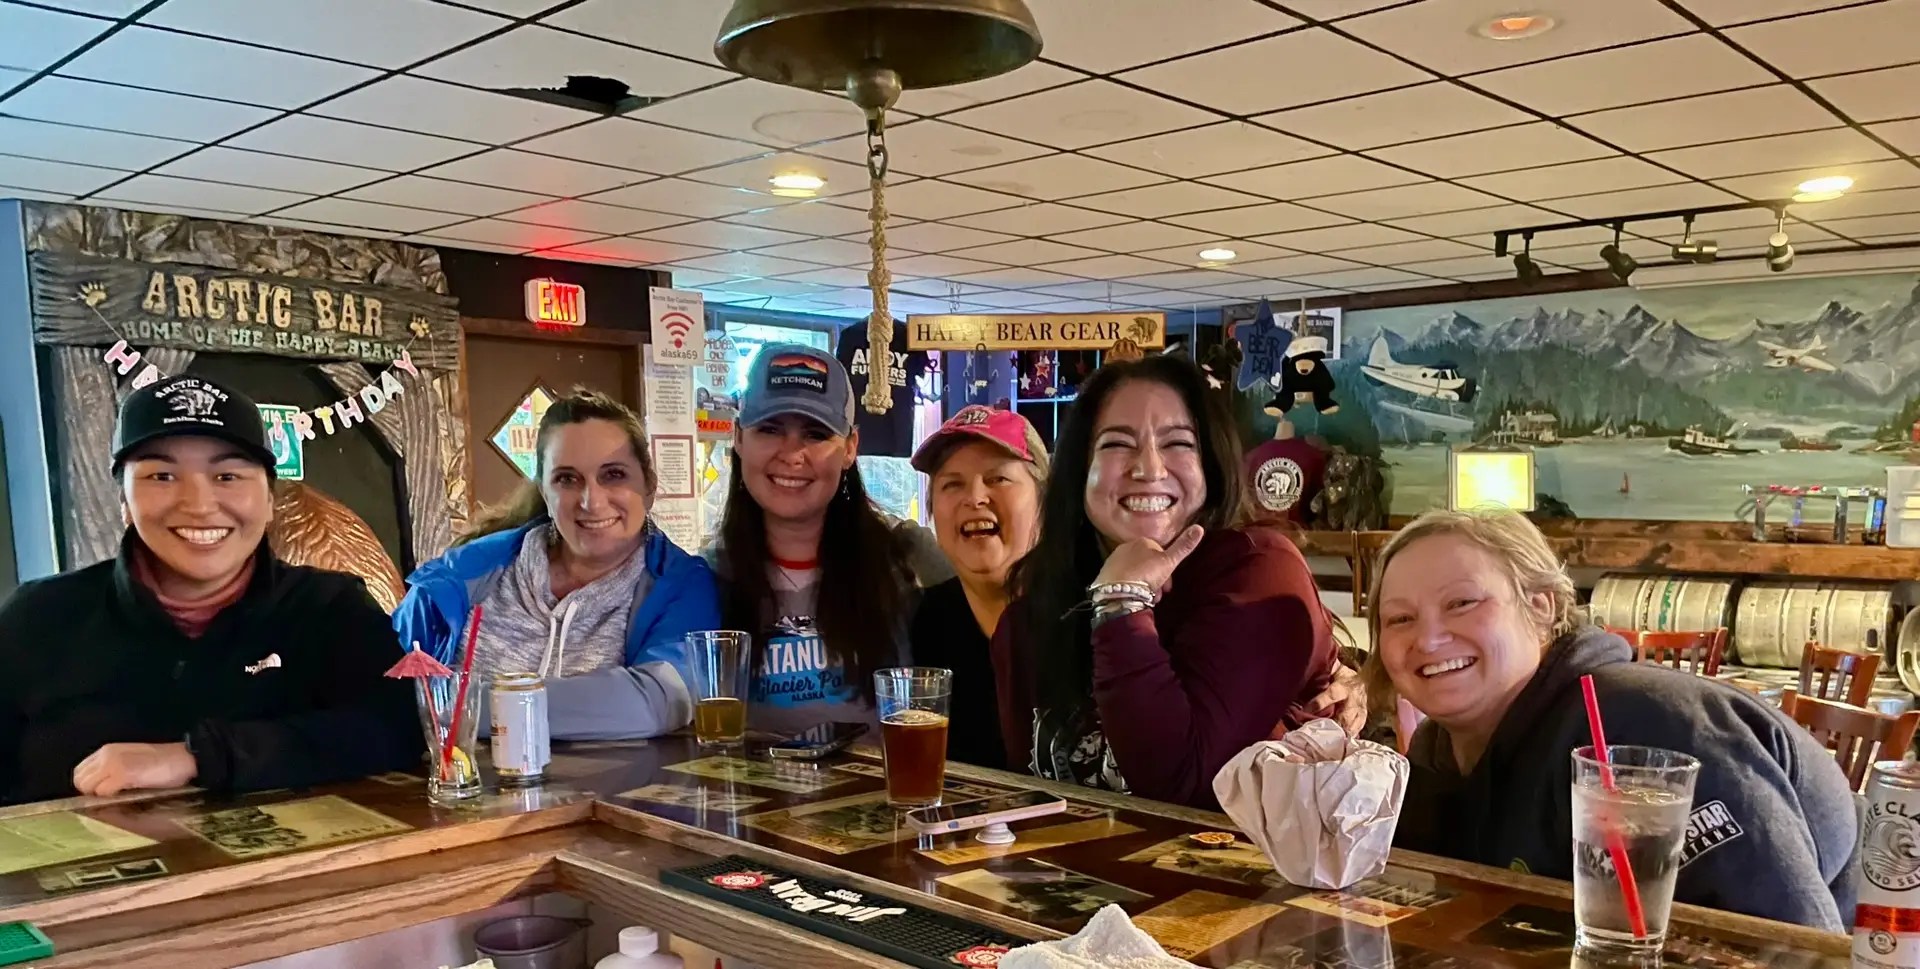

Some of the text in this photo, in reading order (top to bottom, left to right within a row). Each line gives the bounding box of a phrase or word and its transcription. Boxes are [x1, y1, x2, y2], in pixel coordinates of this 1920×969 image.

[142, 270, 382, 337] ARCTIC BAR
[537, 281, 580, 322] EXIT
[121, 320, 182, 340] HOME
[192, 324, 217, 345] OF
[229, 327, 263, 348] THE
[275, 332, 336, 355] HAPPY
[917, 321, 1121, 342] HAY BEAR GEAR
[660, 348, 698, 361] alaska69
[155, 379, 229, 403] ARCTIC BAR
[770, 375, 823, 389] KETCHIKAN
[757, 675, 815, 702] Glacier
[791, 691, 826, 702] ALASKA
